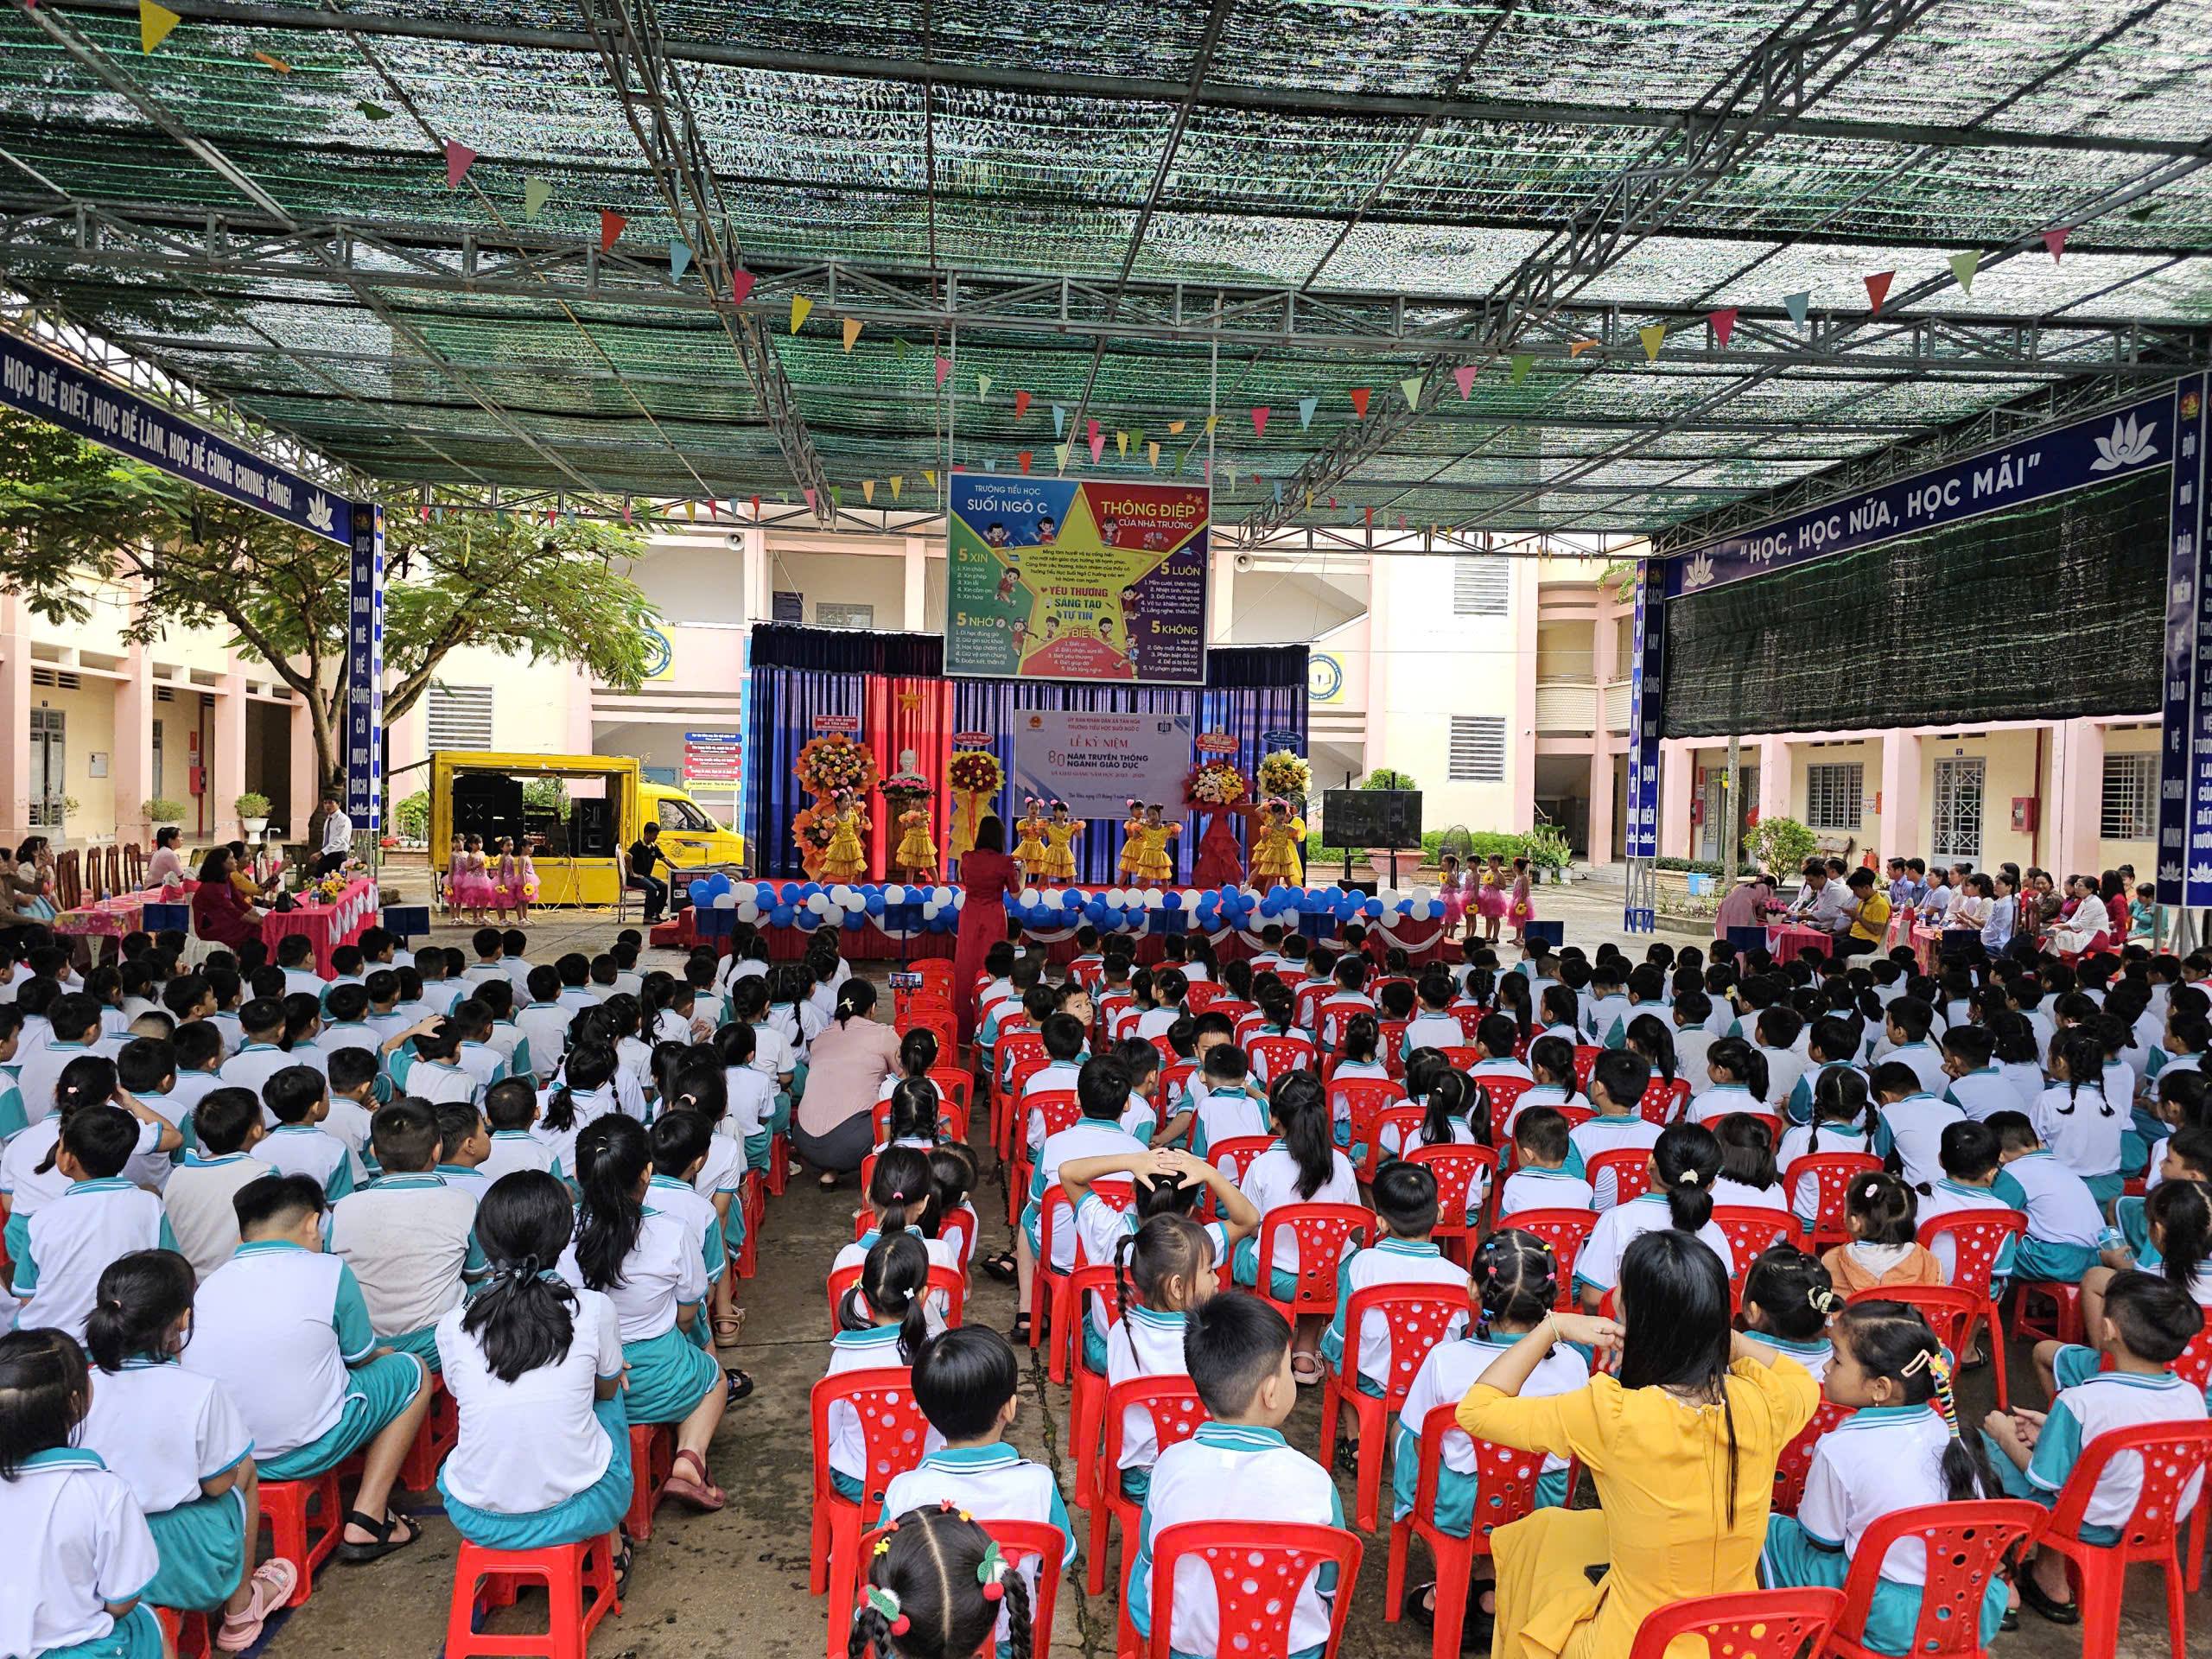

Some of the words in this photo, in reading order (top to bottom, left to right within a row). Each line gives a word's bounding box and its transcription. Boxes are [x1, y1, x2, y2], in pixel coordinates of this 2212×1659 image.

[3, 354, 34, 399] HỌC
[37, 367, 58, 407] ĐỂ
[60, 380, 91, 426] BIẾT,
[93, 396, 119, 436] HỌC
[121, 405, 139, 442] ĐỂ
[139, 416, 167, 459] LÀM,
[169, 432, 190, 468] HỌC
[192, 436, 207, 473] ĐỂ
[207, 448, 232, 485] CÙNG
[235, 463, 264, 499] CHUNG
[267, 475, 292, 511] SỐNG!
[975, 484, 1006, 493] TRƯỜNG
[1007, 485, 1021, 494] TIỂU
[968, 495, 997, 512] SUỐI
[1002, 499, 1033, 513] NGÔ
[1037, 503, 1048, 514] C
[1101, 499, 1156, 516] THÔNG
[1160, 502, 1196, 520] ĐIỆP
[1119, 517, 1136, 526] CỦA
[1157, 518, 1193, 529] TRƯỜNG
[1798, 516, 1840, 551] HỌC
[1849, 498, 1899, 535] NỮA,
[1907, 479, 1961, 520] HỌC
[356, 536, 370, 555] HỌC
[958, 548, 968, 562] 5
[970, 553, 988, 563] XIN
[356, 567, 368, 583] VỚI
[1160, 562, 1169, 575] 5
[1173, 565, 1200, 575] LUÔN
[1050, 585, 1067, 595] YÊU
[1071, 587, 1109, 597] THƯƠNG
[1648, 587, 1663, 605] SÁCH
[353, 597, 369, 613] ĐAM
[1055, 597, 1080, 607] SÁNG
[1084, 600, 1102, 610] TẠO
[957, 612, 966, 626] 5
[969, 615, 995, 627] NHỚ
[1064, 610, 1076, 621] TỰ
[355, 625, 366, 643] MÊ
[1061, 625, 1069, 638] 5
[1071, 625, 1096, 639] BIẾT
[1151, 620, 1160, 633] 5
[1162, 624, 1198, 635] KHÔNG
[1648, 633, 1659, 650] HAY
[356, 652, 366, 674] ĐỂ
[351, 684, 370, 703] SỐNG
[355, 714, 365, 734] CÓ
[1085, 735, 1097, 747] KỶ
[1103, 735, 1128, 749] NIỆM
[353, 747, 368, 767] MỤC
[1049, 750, 1065, 766] 80
[1643, 766, 1656, 784] BẠN
[351, 779, 367, 795] ĐÍCH
